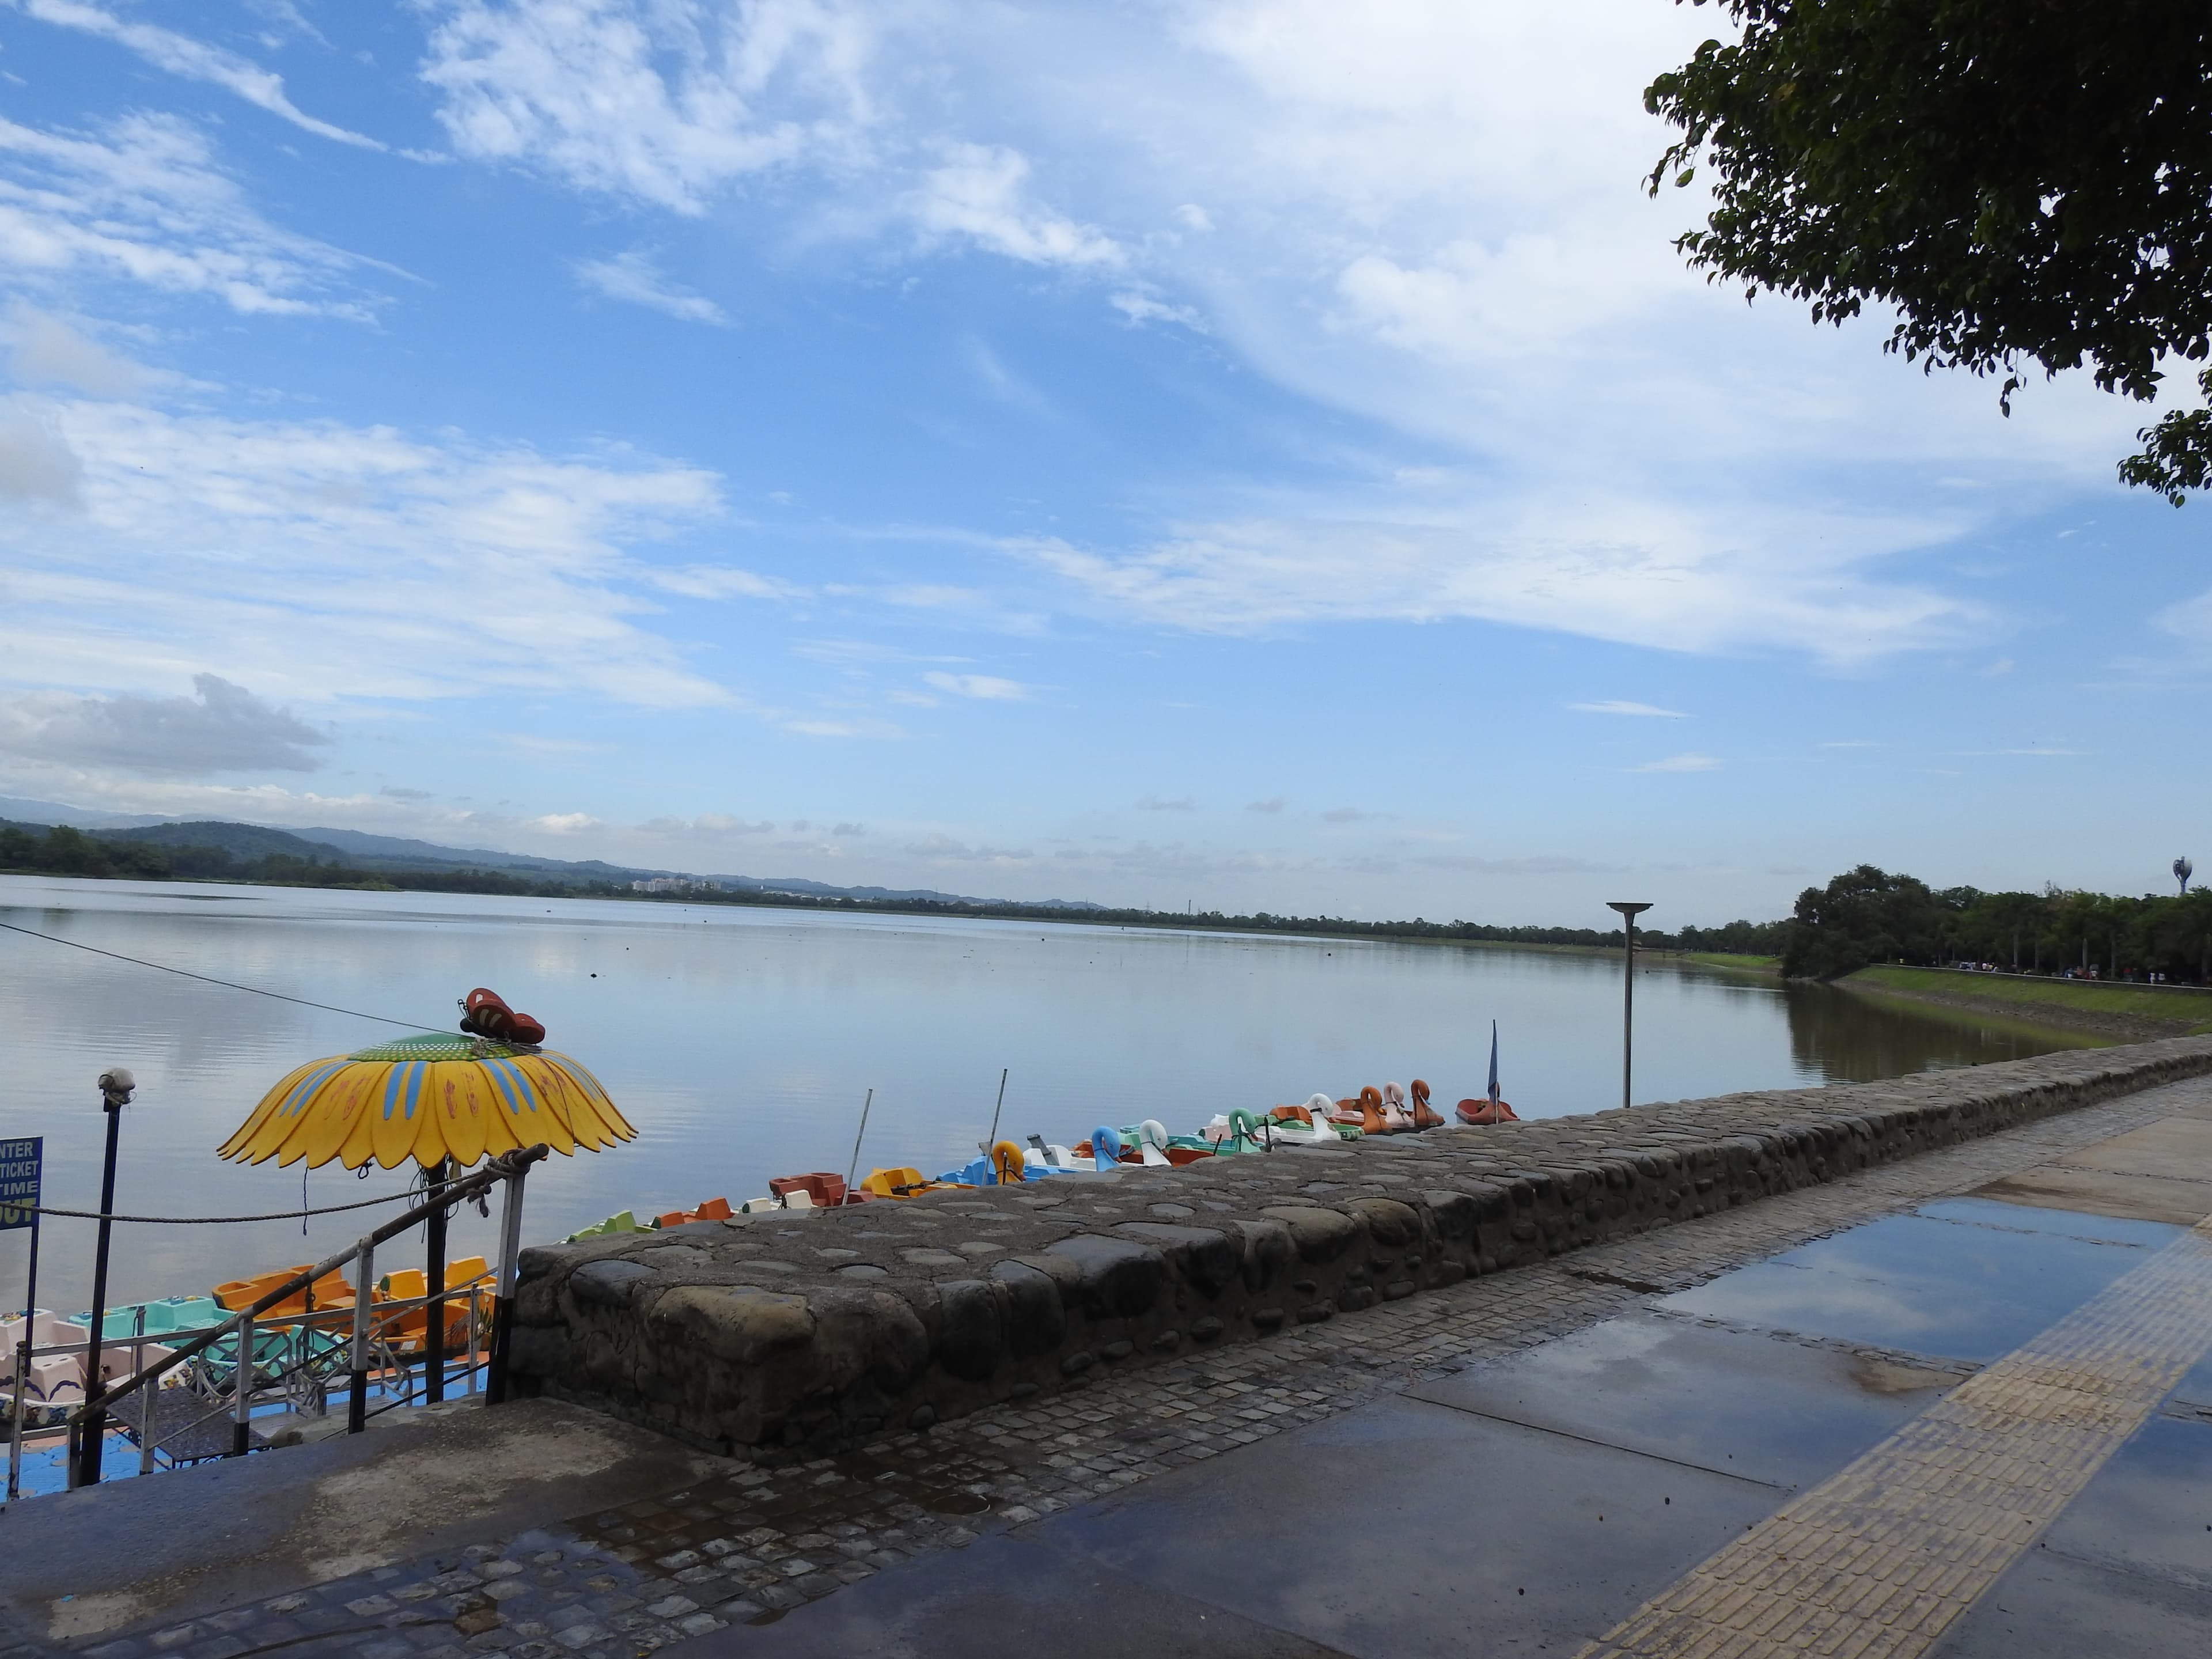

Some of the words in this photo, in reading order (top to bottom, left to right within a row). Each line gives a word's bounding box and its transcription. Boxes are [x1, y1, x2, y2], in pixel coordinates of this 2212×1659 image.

[0, 1160, 38, 1179] TICKET
[0, 1181, 37, 1195] IME
[0, 1198, 36, 1224] UT
